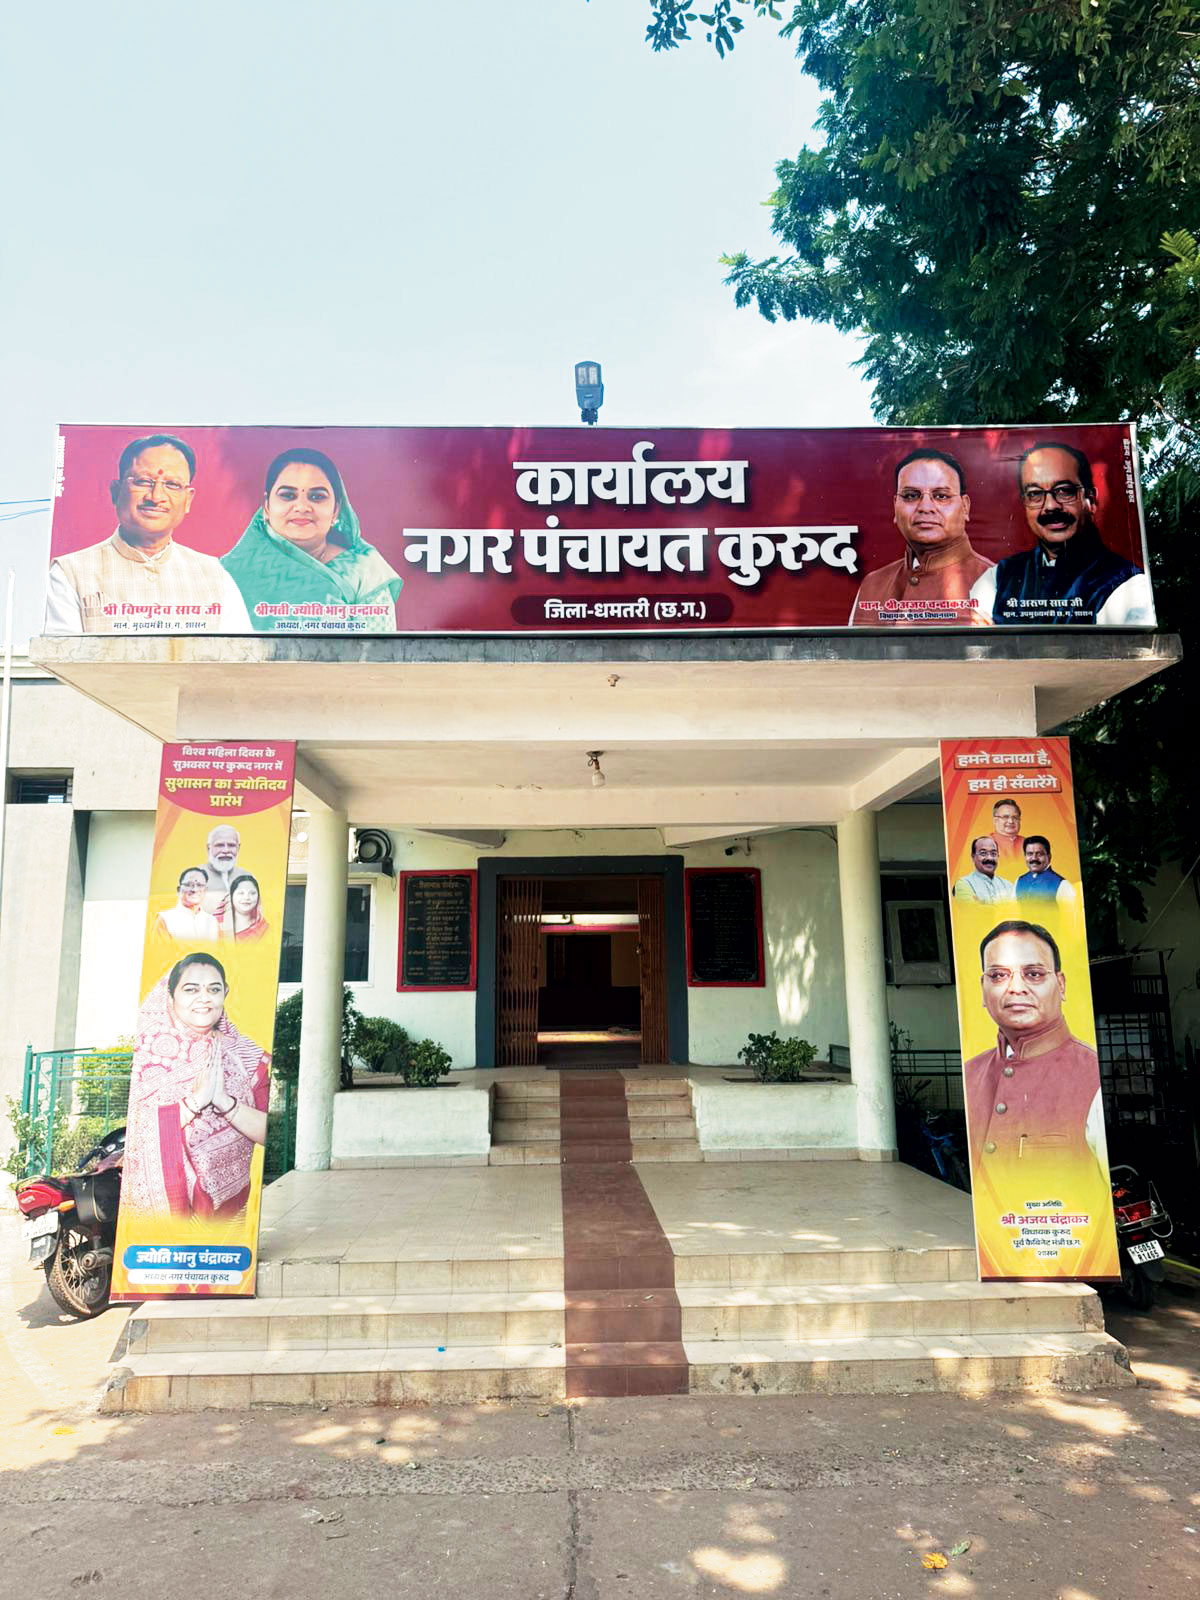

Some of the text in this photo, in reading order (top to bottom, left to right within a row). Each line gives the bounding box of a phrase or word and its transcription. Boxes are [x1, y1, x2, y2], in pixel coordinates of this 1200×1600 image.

[513, 441, 748, 505] कार्यालय
[402, 515, 858, 587] नगर पंचायत कुरुद
[544, 598, 706, 620] जिला-धमतरी (छ.ग.)
[1006, 597, 1018, 607] श्री
[103, 603, 221, 619] श्री विष्णुदेव साय जी
[255, 602, 290, 616] श्रीमती
[292, 602, 322, 616] ज्योति
[325, 605, 346, 619] भानु
[182, 746, 276, 758] विश्व महिला दिवस के
[957, 751, 990, 766] हमने
[992, 753, 1035, 765] बनाया
[173, 760, 210, 772] सुअवसर
[212, 761, 225, 769] पर
[254, 762, 273, 771] नगर
[275, 760, 283, 770] में
[165, 777, 212, 792] सुशासन
[215, 778, 232, 790] का
[968, 779, 990, 792] हम
[992, 775, 1007, 791] ही
[210, 792, 243, 807] प्रारंभ
[1001, 1212, 1089, 1224] श्री अजय चंद्राकर
[136, 1248, 241, 1268] ज्योति भानु चंद्राकर
[168, 1273, 183, 1281] नगर
[184, 1271, 209, 1281] पंचायत
